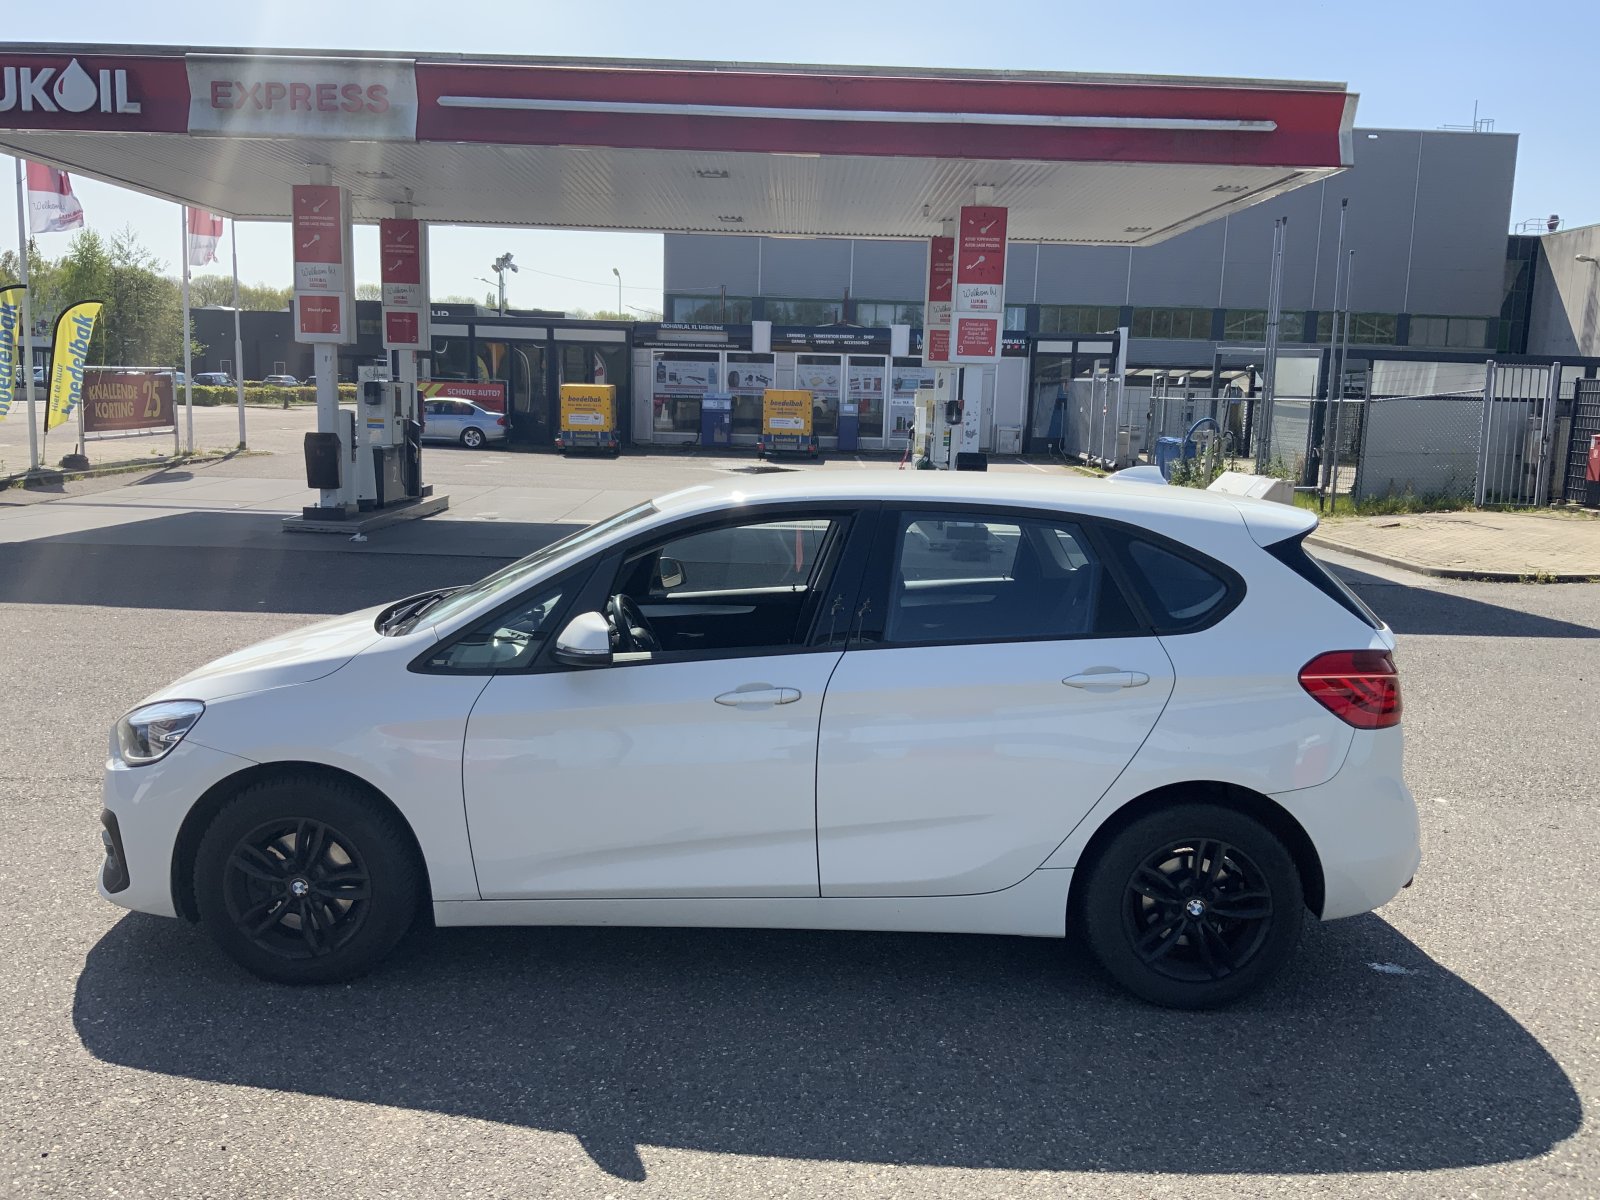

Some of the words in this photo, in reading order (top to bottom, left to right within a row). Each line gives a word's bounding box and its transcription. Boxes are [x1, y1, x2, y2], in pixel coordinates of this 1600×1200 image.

[210, 80, 389, 113] EXPRESS
[963, 288, 989, 297] Welkom
[302, 323, 306, 331] 1
[332, 323, 338, 332] 2
[958, 345, 964, 354] 3
[987, 346, 993, 355] 4
[62, 313, 94, 415] boedelbak
[56, 363, 66, 382] huur
[54, 381, 61, 393] te
[447, 388, 476, 396] SCHONE
[477, 389, 501, 397] AUTO?
[52, 394, 61, 412] Hier
[89, 381, 138, 401] KNALLENDE
[142, 380, 162, 419] 25
[568, 395, 602, 403] boedelbak
[95, 401, 135, 419] KORTING
